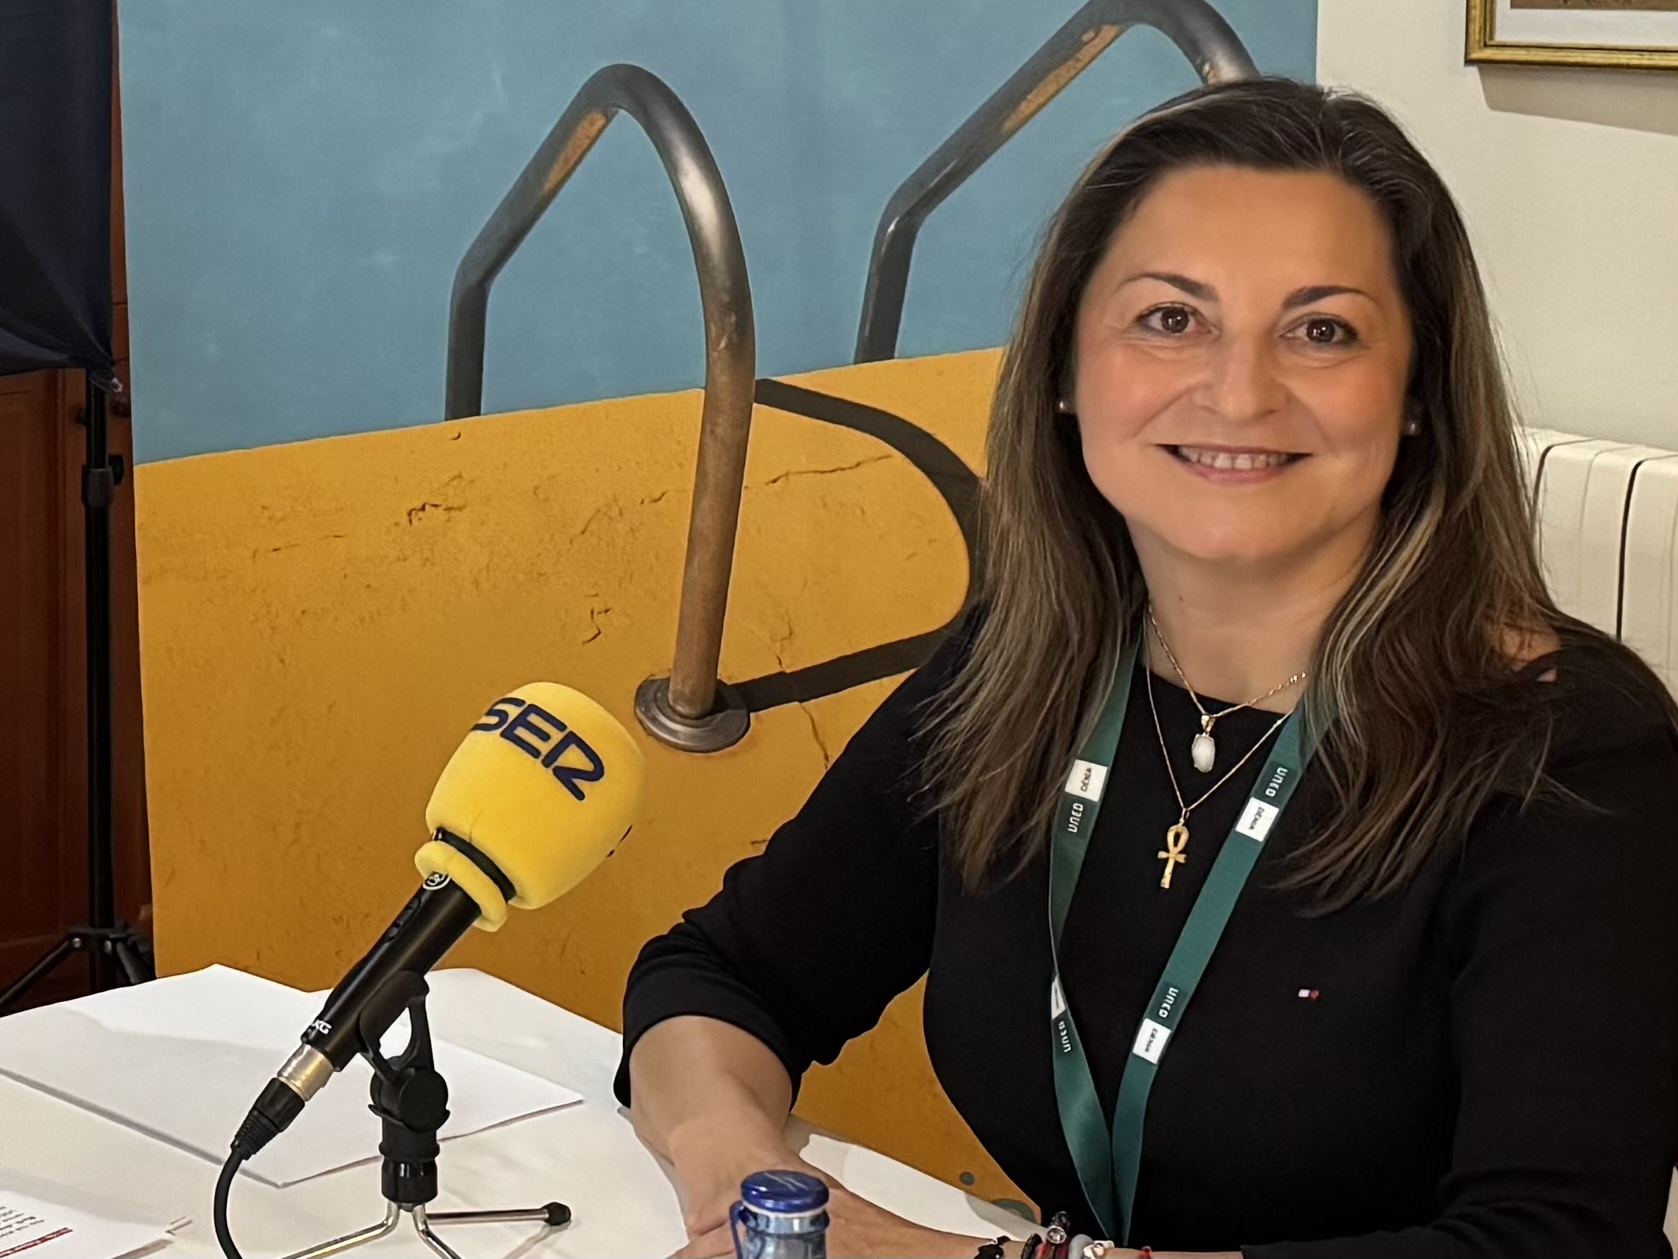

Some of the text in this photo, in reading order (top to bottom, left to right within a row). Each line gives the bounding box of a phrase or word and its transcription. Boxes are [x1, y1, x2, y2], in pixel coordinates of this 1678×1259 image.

[469, 697, 605, 801] SER
[1265, 766, 1289, 798] UNED
[1067, 802, 1084, 833] UNED
